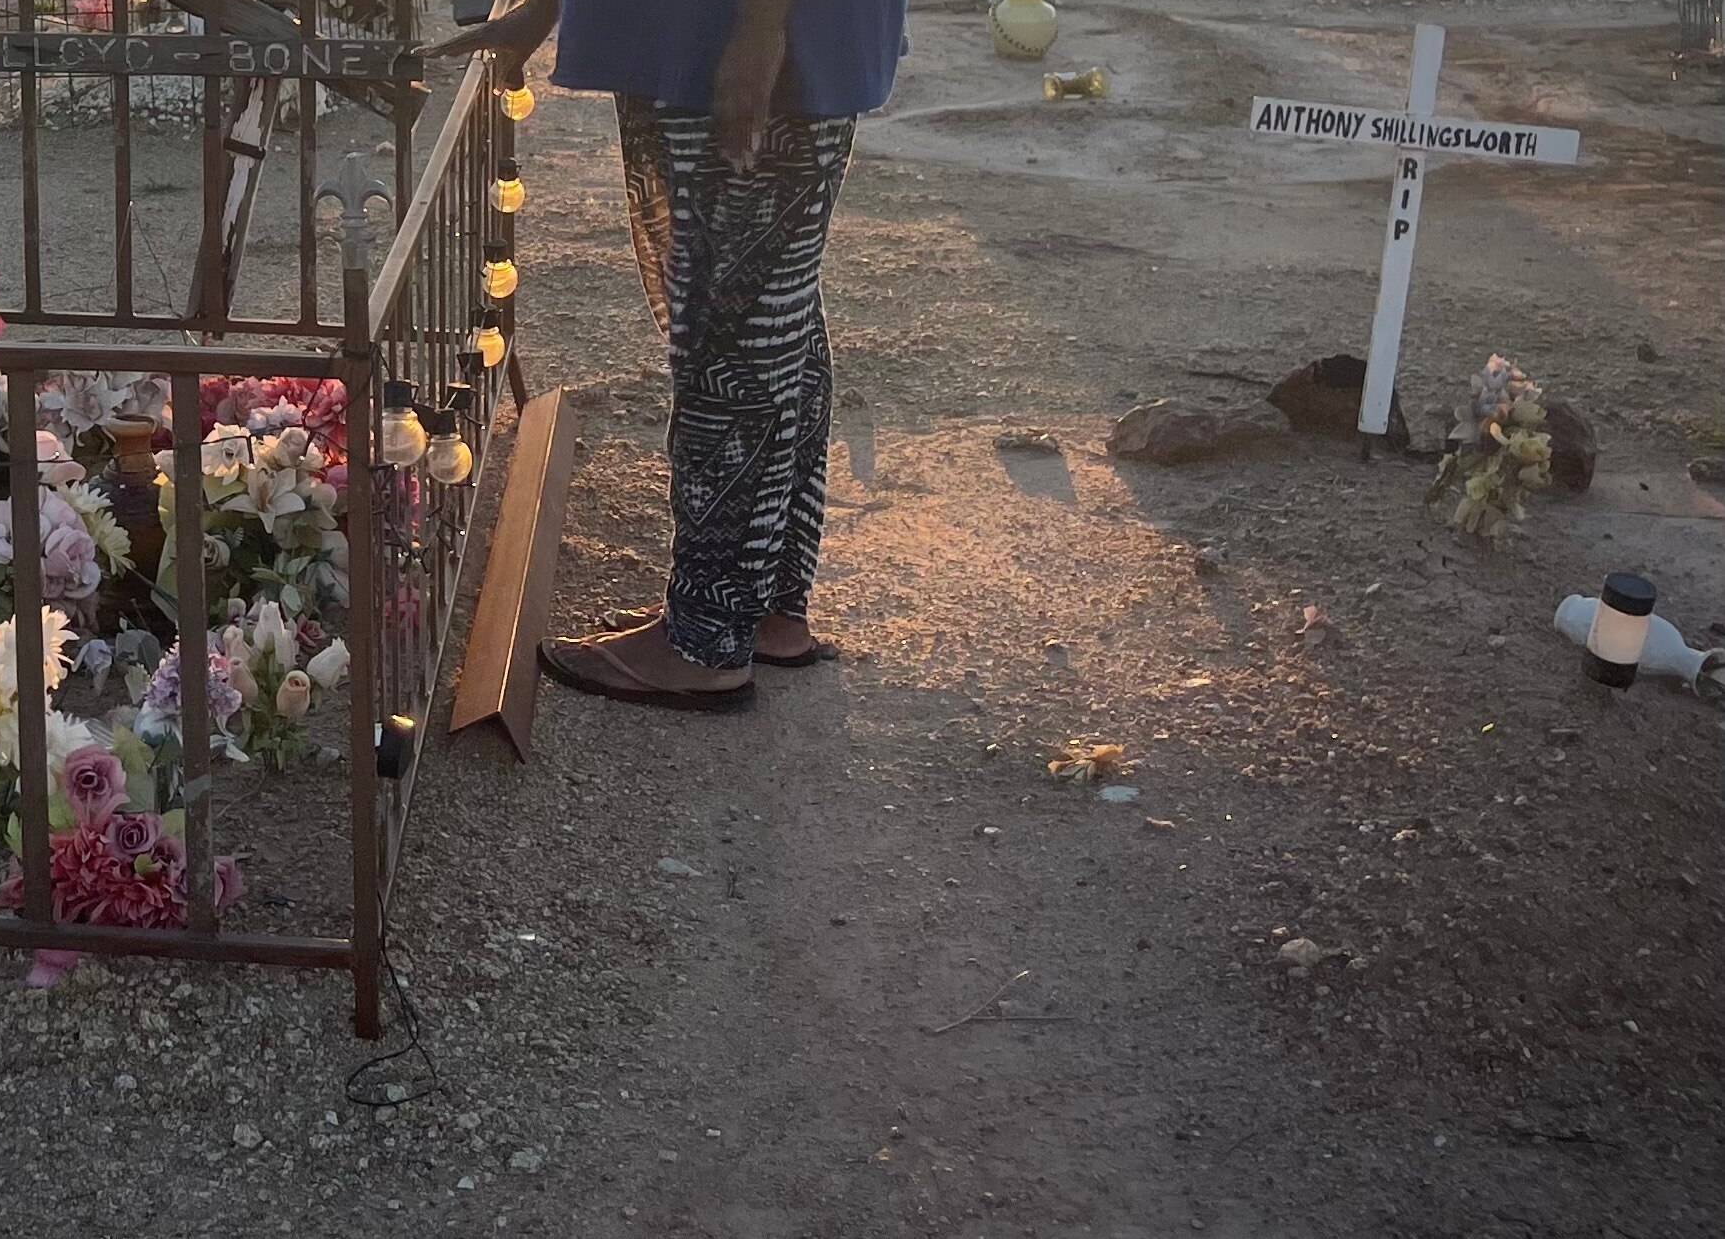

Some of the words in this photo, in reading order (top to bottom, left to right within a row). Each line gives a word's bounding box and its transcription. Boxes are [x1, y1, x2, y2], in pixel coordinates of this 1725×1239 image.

[228, 39, 405, 77] BONEY
[1256, 103, 1366, 139] ANTHONY
[1371, 116, 1538, 156] SHILLINGSWORTH
